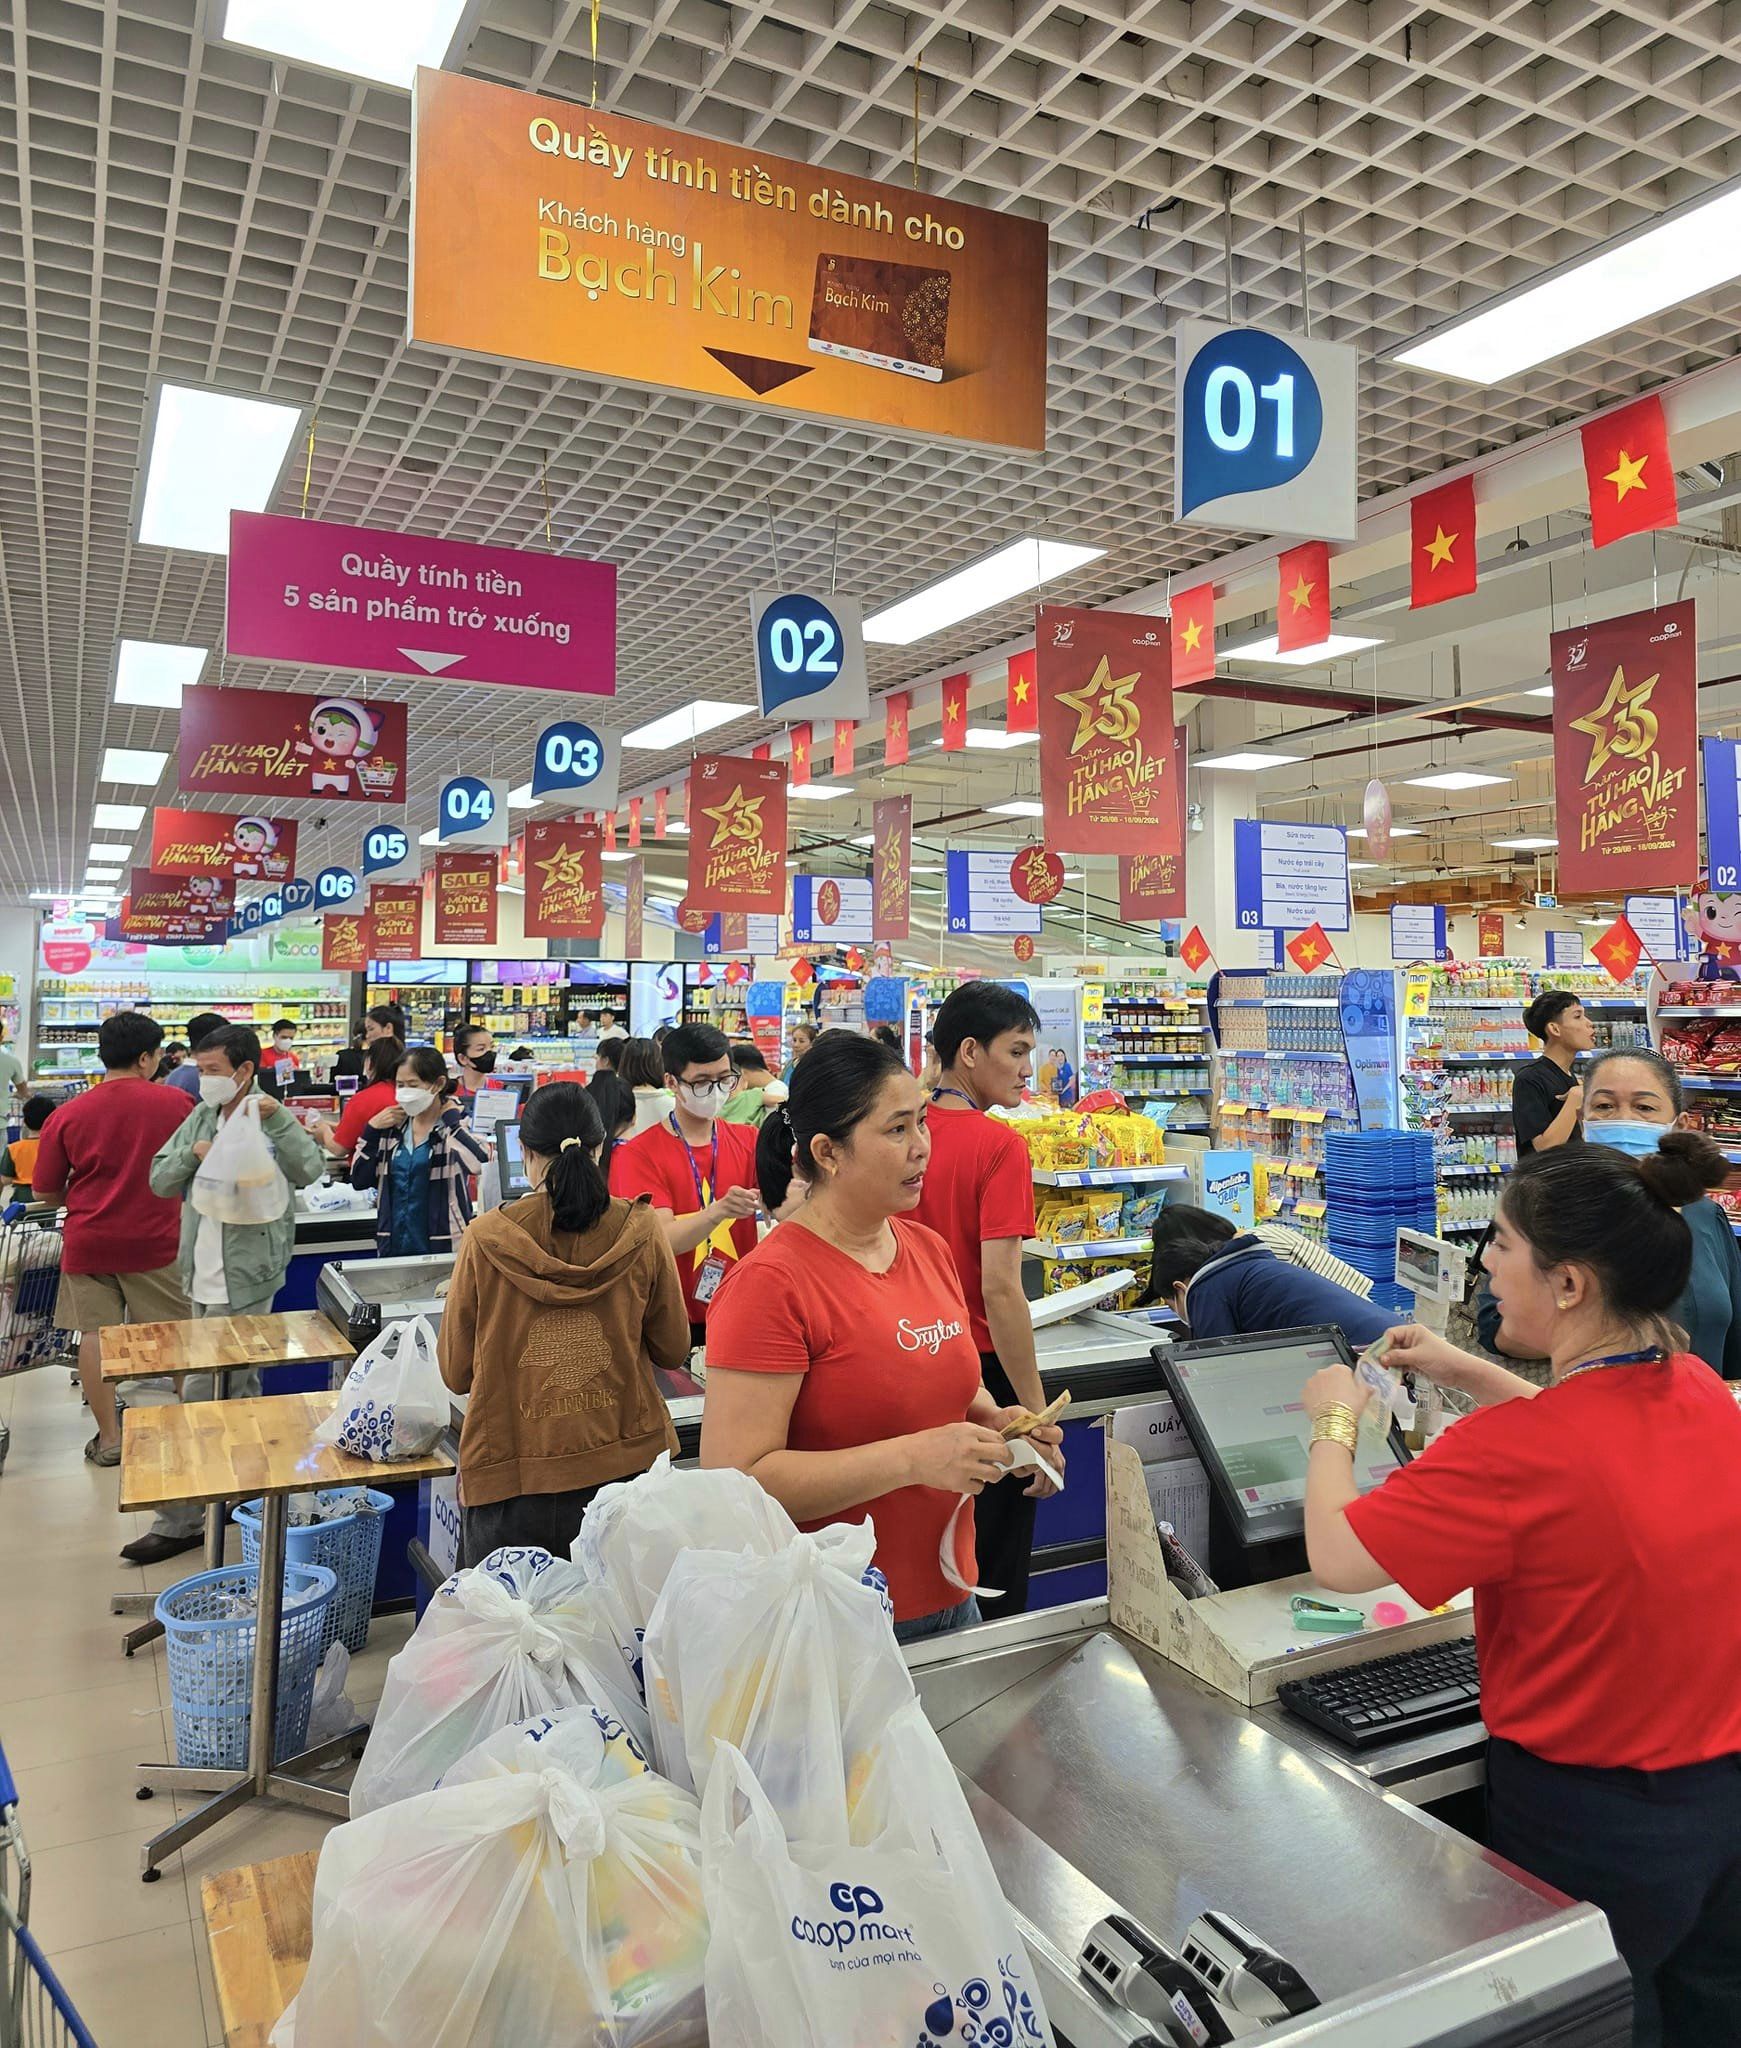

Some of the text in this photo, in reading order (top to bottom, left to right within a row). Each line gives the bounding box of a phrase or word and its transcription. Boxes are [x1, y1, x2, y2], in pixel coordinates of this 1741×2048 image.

[528, 117, 966, 250] Quầy tính tiền dành cho
[538, 198, 686, 258] Khách hàng
[537, 226, 793, 328] Bạch Kim
[825, 287, 889, 313] Bạch Kim
[1204, 365, 1294, 458] 01
[341, 552, 522, 598] Quầy tính tiền
[283, 586, 571, 645] 5 sản phẩm trở xuống
[769, 618, 839, 674] 02
[1096, 683, 1141, 741] 35
[1611, 691, 1659, 759] 35
[264, 739, 309, 779] VIỆT
[545, 735, 598, 777] 03
[1125, 738, 1166, 788] VIỆT
[1073, 759, 1098, 783] TỰ
[1641, 751, 1687, 810] VIỆT
[447, 787, 493, 821] 04
[1587, 783, 1612, 814] TỰ
[732, 805, 764, 841] 35
[368, 833, 407, 860] 05
[749, 838, 780, 871] VIỆT
[320, 874, 354, 898] 06
[443, 873, 489, 887] SALE
[1717, 866, 1737, 886] 02
[264, 897, 282, 916] 0
[285, 885, 311, 903] 07
[376, 901, 415, 914] SALE
[952, 918, 966, 929] 04
[1241, 910, 1258, 925] 03
[706, 943, 719, 952] 06
[797, 929, 810, 940] 05
[1436, 949, 1446, 958] 05
[1355, 1059, 1390, 1072] Optimum
[1209, 1173, 1248, 1193] Alpenliebe
[1218, 1187, 1239, 1205] Jelly
[847, 1955, 870, 1970] của
[872, 1951, 895, 1966] mọi
